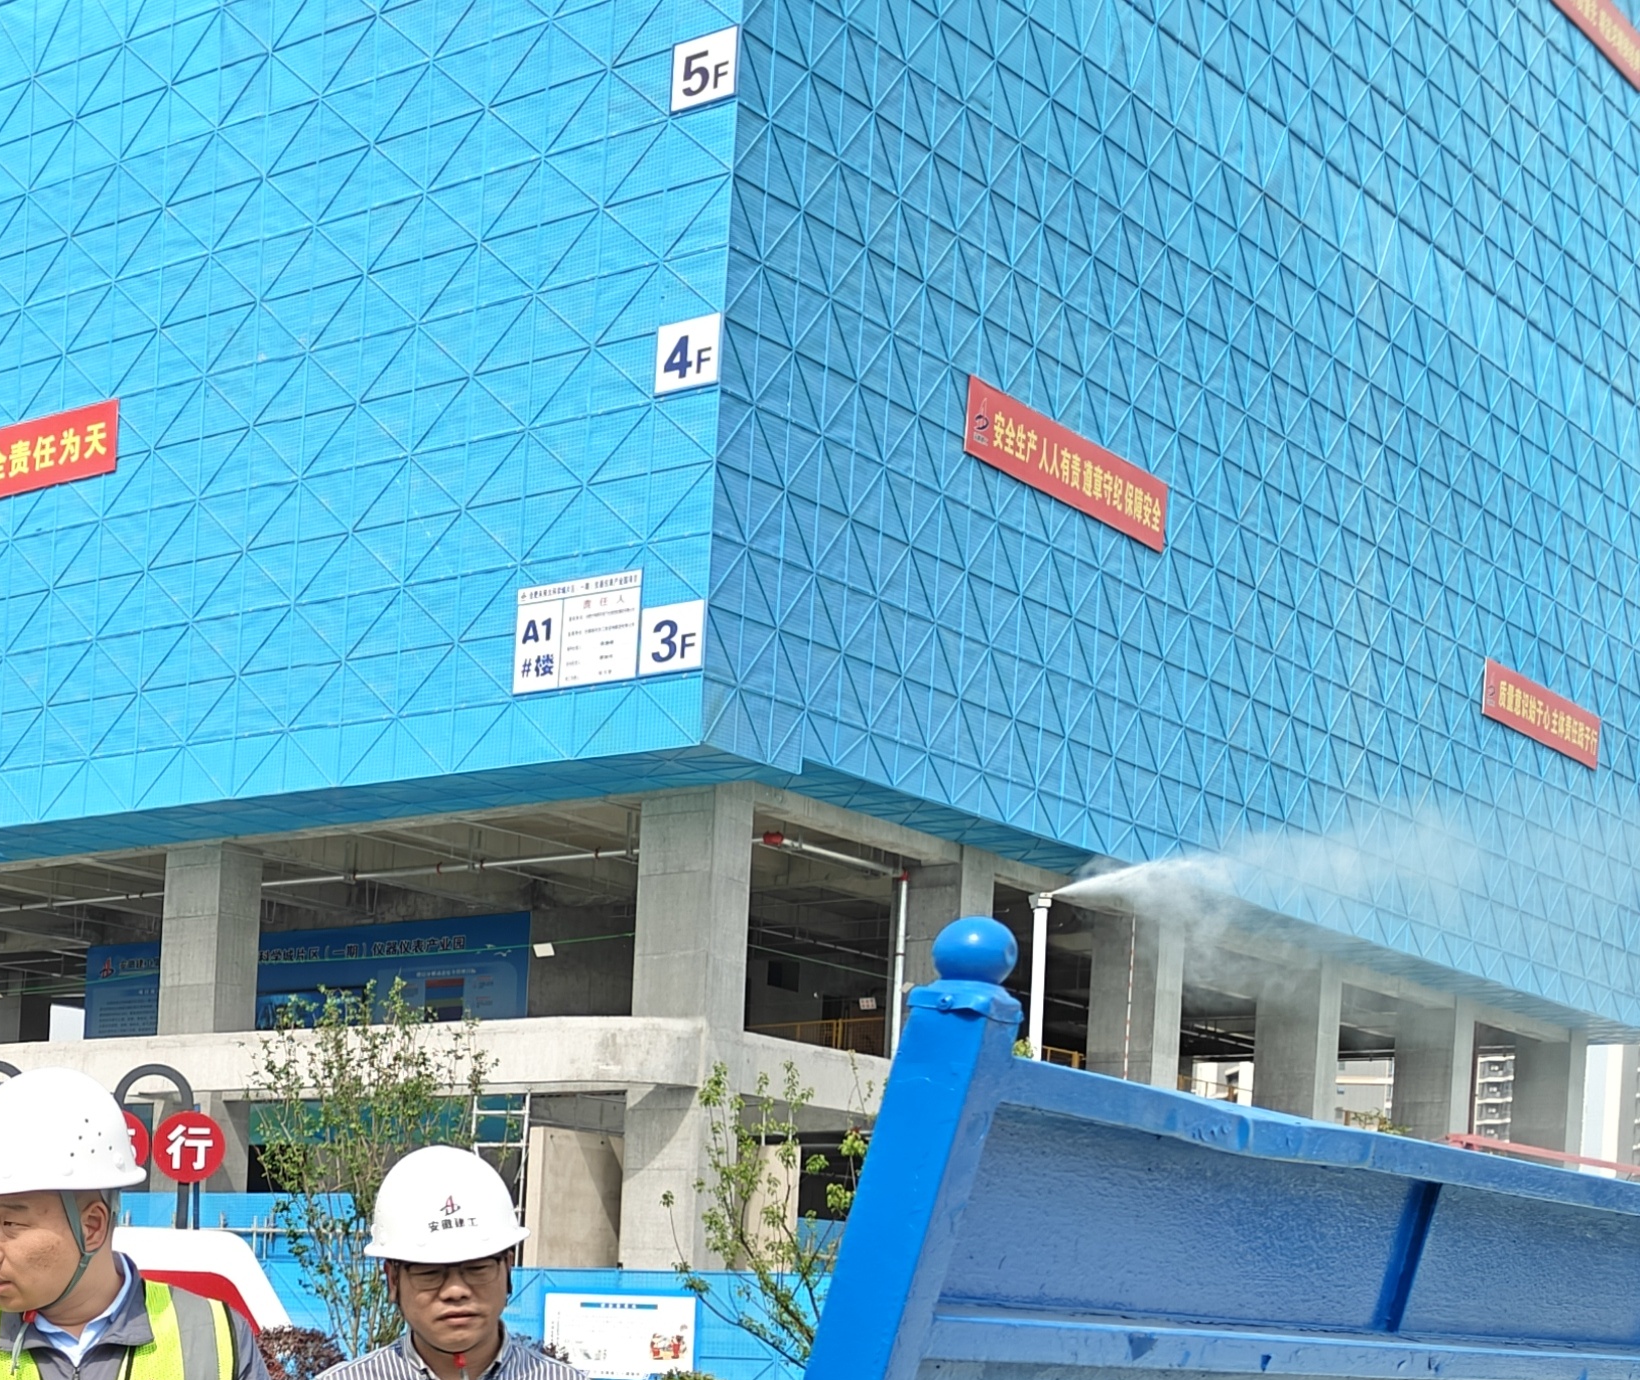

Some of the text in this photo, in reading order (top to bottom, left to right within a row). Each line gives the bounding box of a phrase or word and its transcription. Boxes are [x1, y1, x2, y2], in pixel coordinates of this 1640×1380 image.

[682, 50, 729, 97] 5F
[663, 334, 712, 379] 4F
[992, 411, 1161, 532] 安全生产 人人有责 遵章守纪 保障安全
[522, 617, 552, 645] A1
[651, 619, 697, 664] 3F
[521, 653, 555, 678] #楼
[166, 1123, 213, 1171] 行
[428, 1217, 478, 1233] 安徽建工
